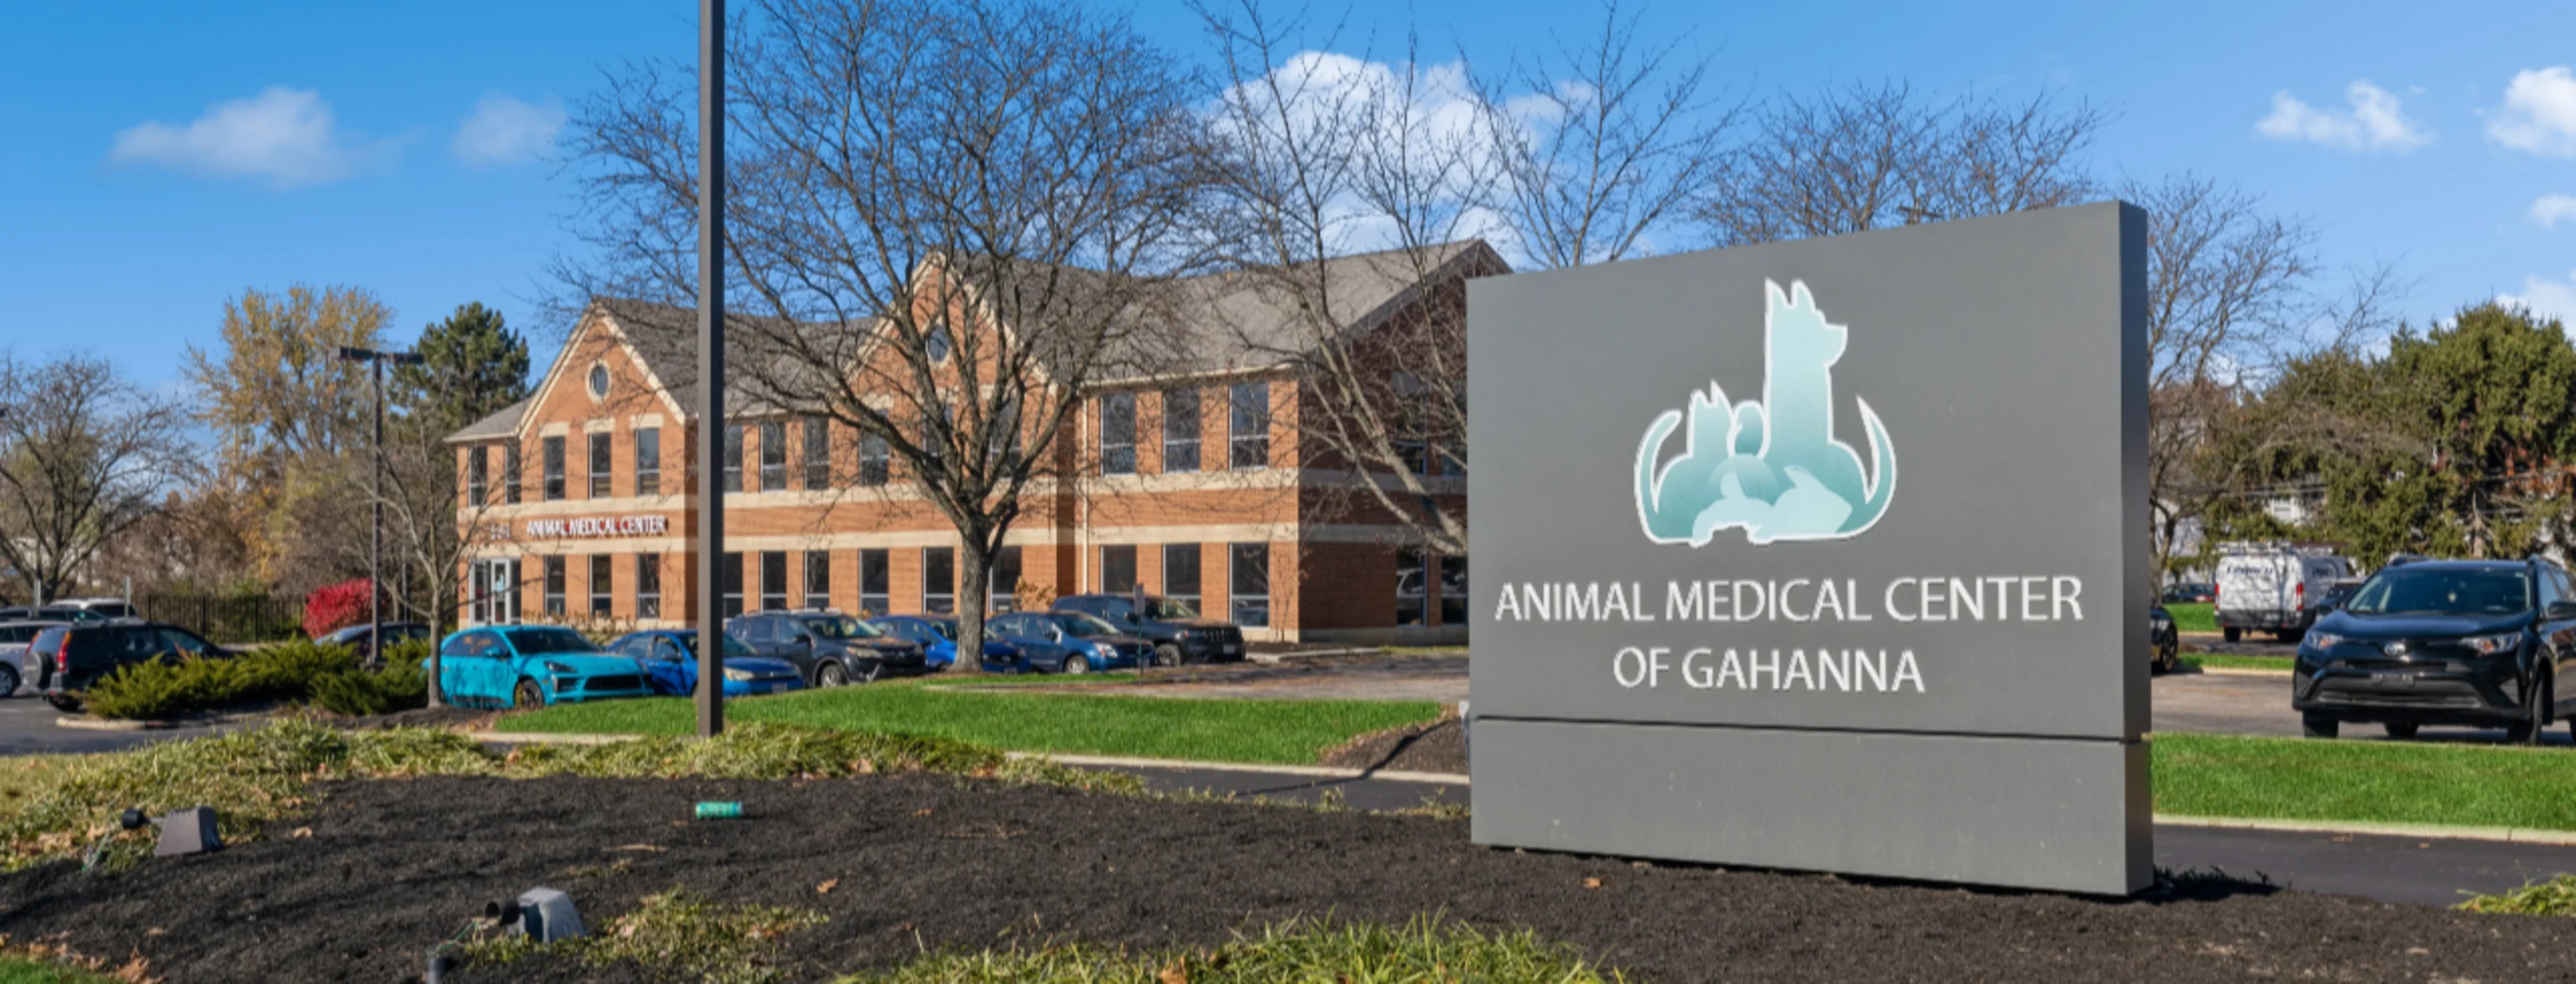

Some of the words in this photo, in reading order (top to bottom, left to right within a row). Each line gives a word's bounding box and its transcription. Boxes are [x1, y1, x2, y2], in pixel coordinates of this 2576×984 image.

[526, 519, 566, 535] ANIMAL
[569, 516, 618, 535] MEDICAL
[620, 515, 666, 534] CENTER
[1494, 581, 1655, 621] ANIMAL
[1665, 578, 1873, 622] MEDICAL
[1885, 575, 2083, 622] CENTER
[1613, 646, 1670, 688] OF
[1682, 647, 1925, 693] GAHANNA
